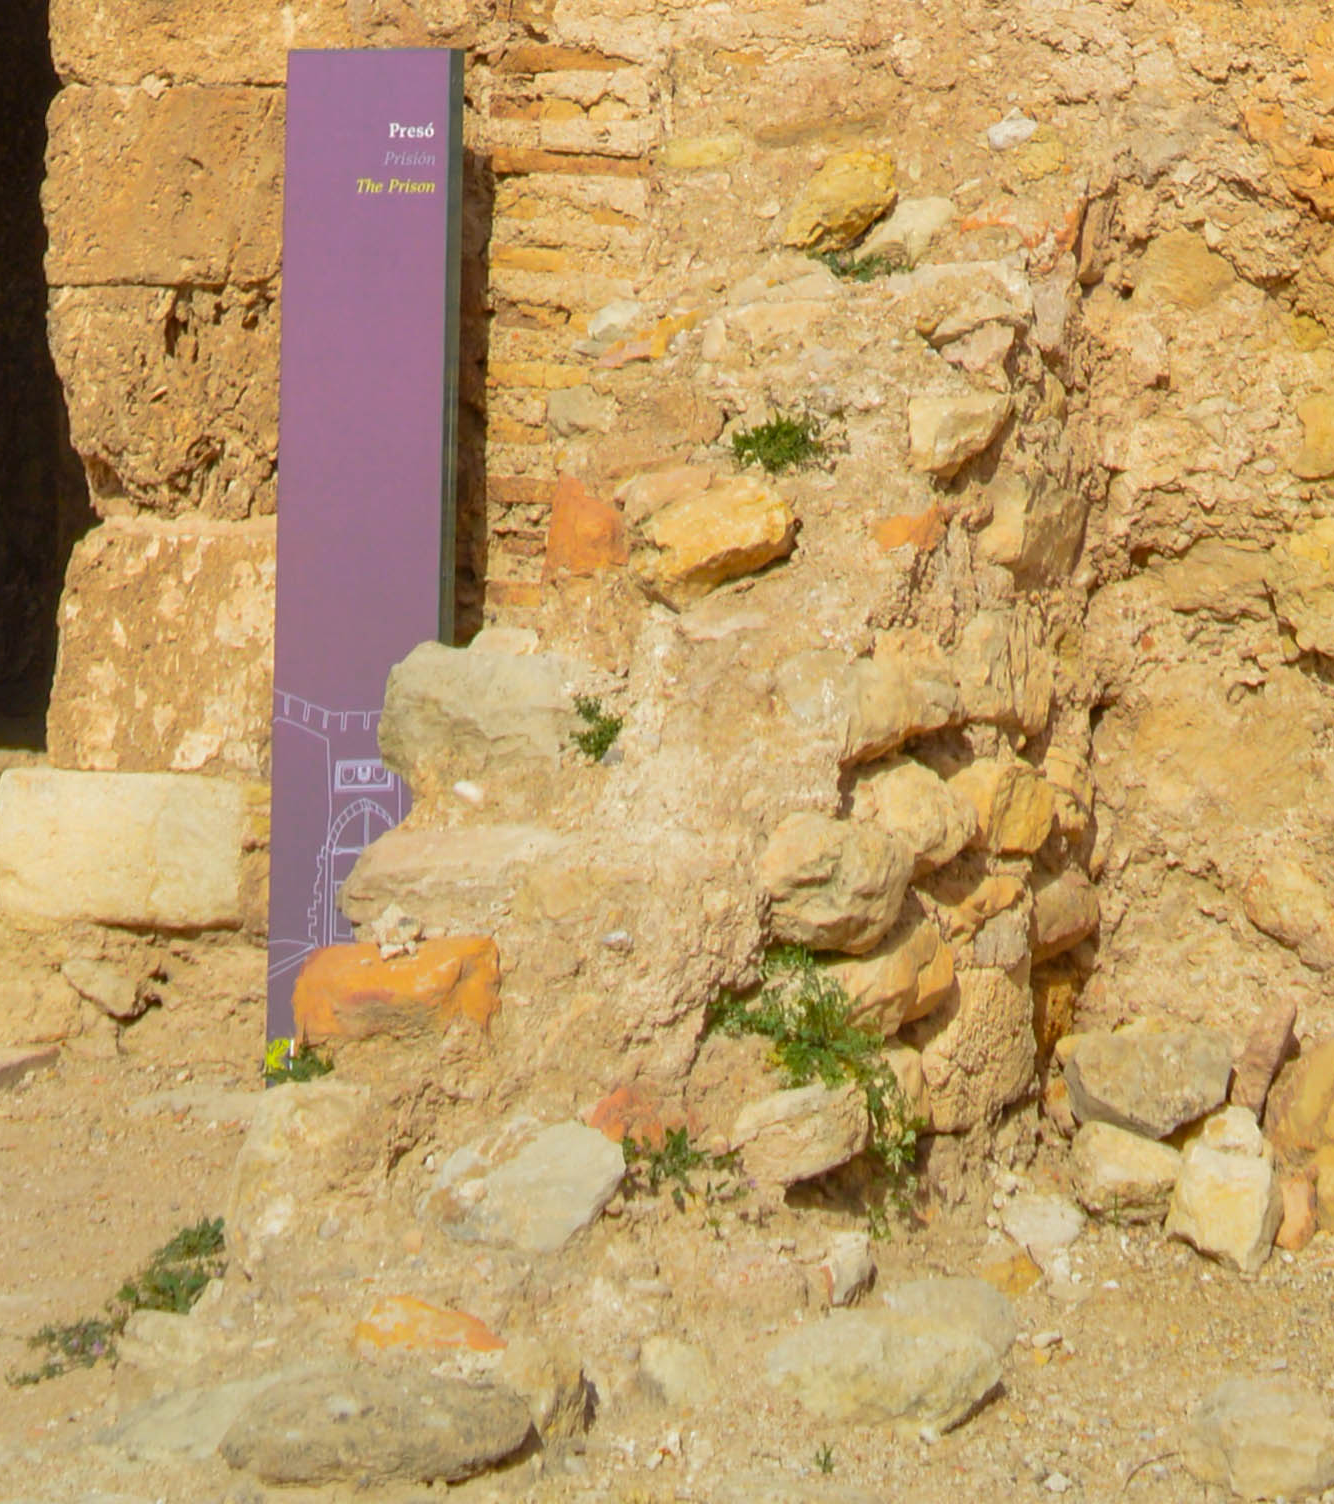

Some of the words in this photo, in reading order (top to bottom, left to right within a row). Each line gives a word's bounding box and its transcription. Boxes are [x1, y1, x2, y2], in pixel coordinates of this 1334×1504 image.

[388, 121, 435, 139] Presó
[384, 149, 436, 166] Prisión
[356, 179, 383, 194] The
[388, 178, 436, 194] Prison
